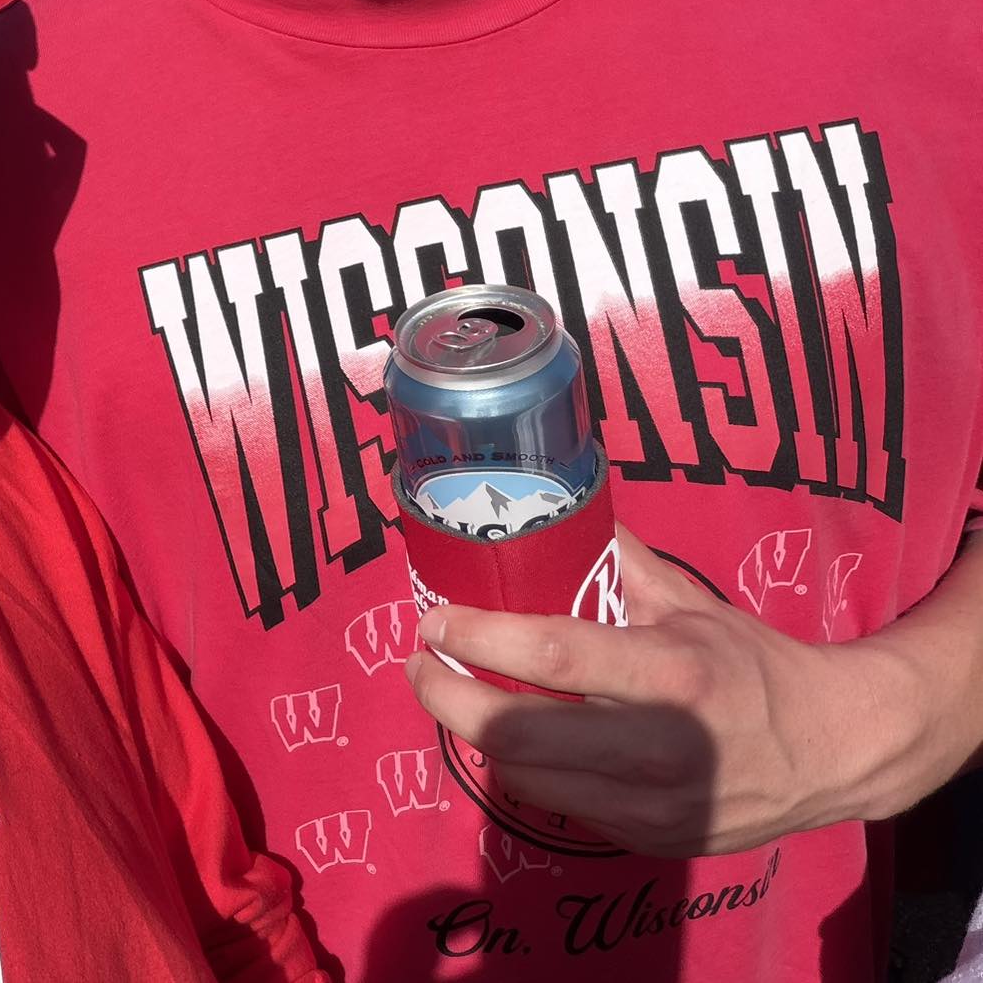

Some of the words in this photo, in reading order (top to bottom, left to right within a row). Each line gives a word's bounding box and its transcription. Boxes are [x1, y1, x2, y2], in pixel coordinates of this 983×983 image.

[417, 456, 447, 468] COLD
[453, 454, 485, 463] AND
[490, 452, 555, 465] SMOOTH
